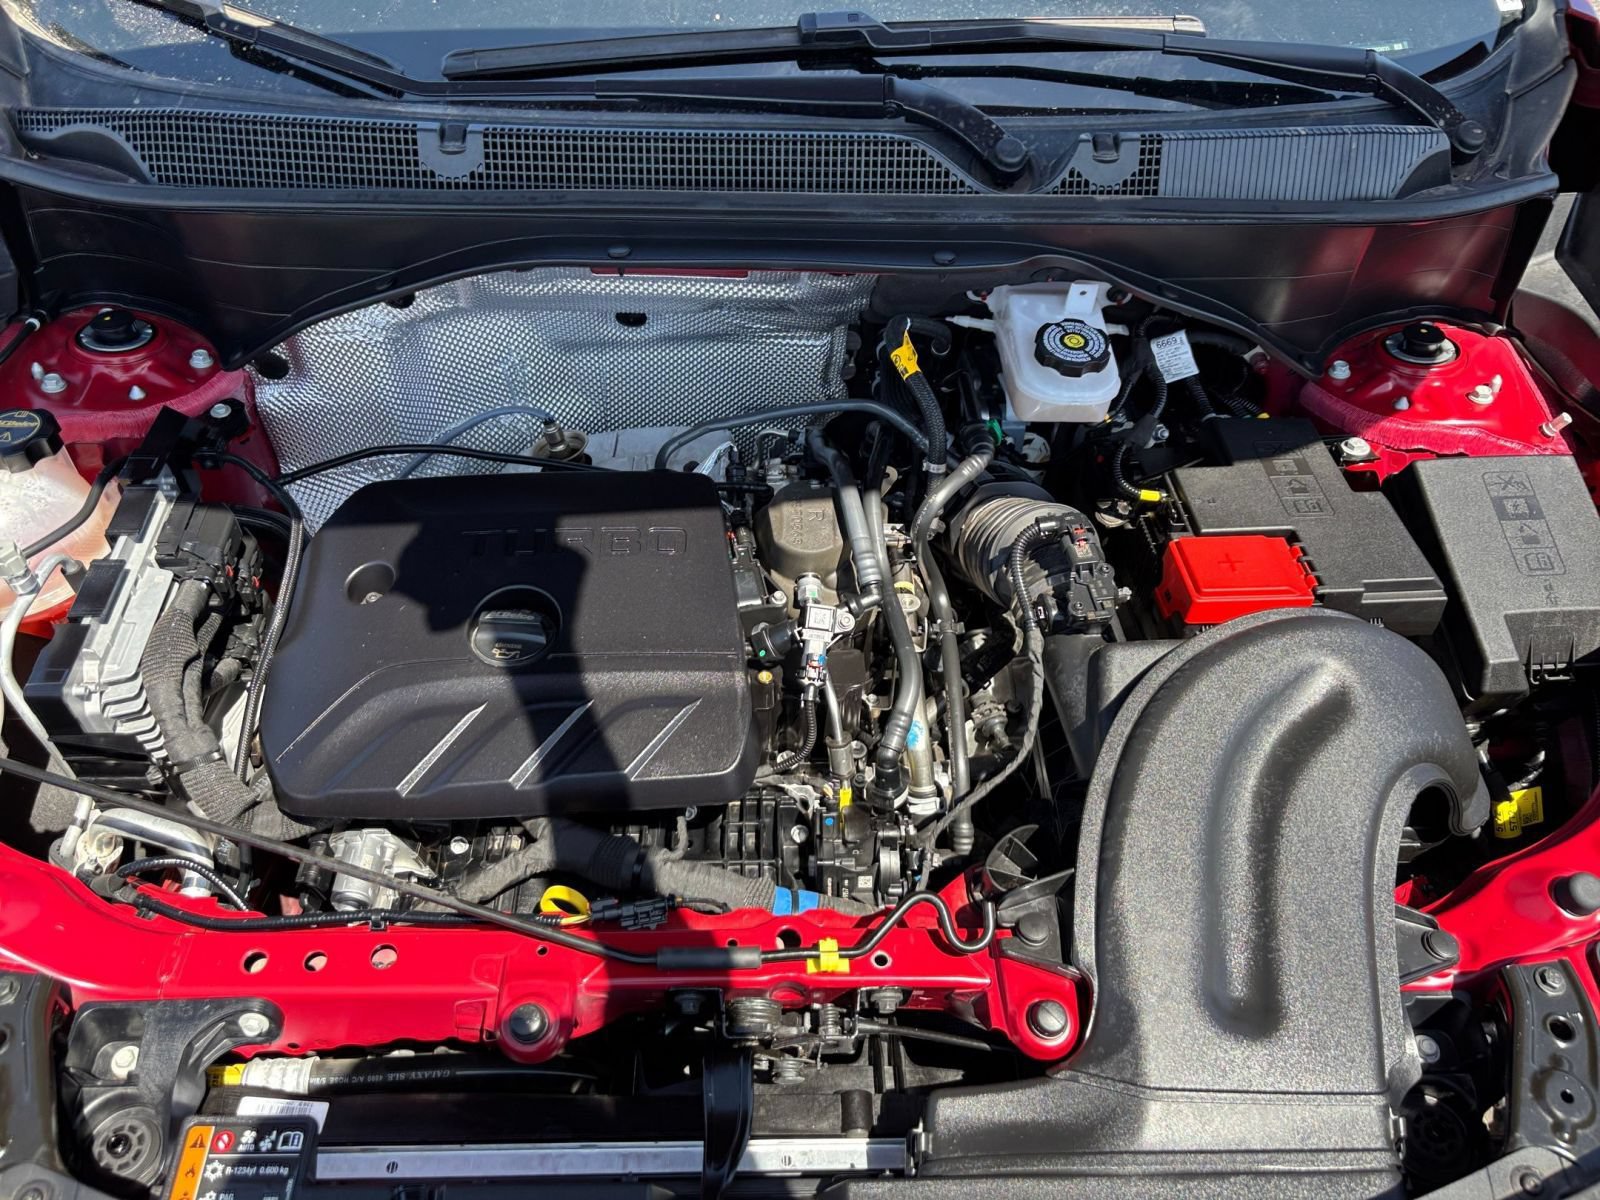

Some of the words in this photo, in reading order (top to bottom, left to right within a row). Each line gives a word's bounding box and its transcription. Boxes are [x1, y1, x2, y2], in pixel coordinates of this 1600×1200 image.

[1156, 336, 1178, 349] 6669
[460, 525, 688, 556] TURBO
[483, 611, 535, 621] ACDelco
[387, 1072, 406, 1081] SLE
[409, 1069, 451, 1080] GALAXY
[237, 1143, 255, 1152] AUTO
[225, 1165, 257, 1177] R-1234yf
[279, 1165, 290, 1177] kg
